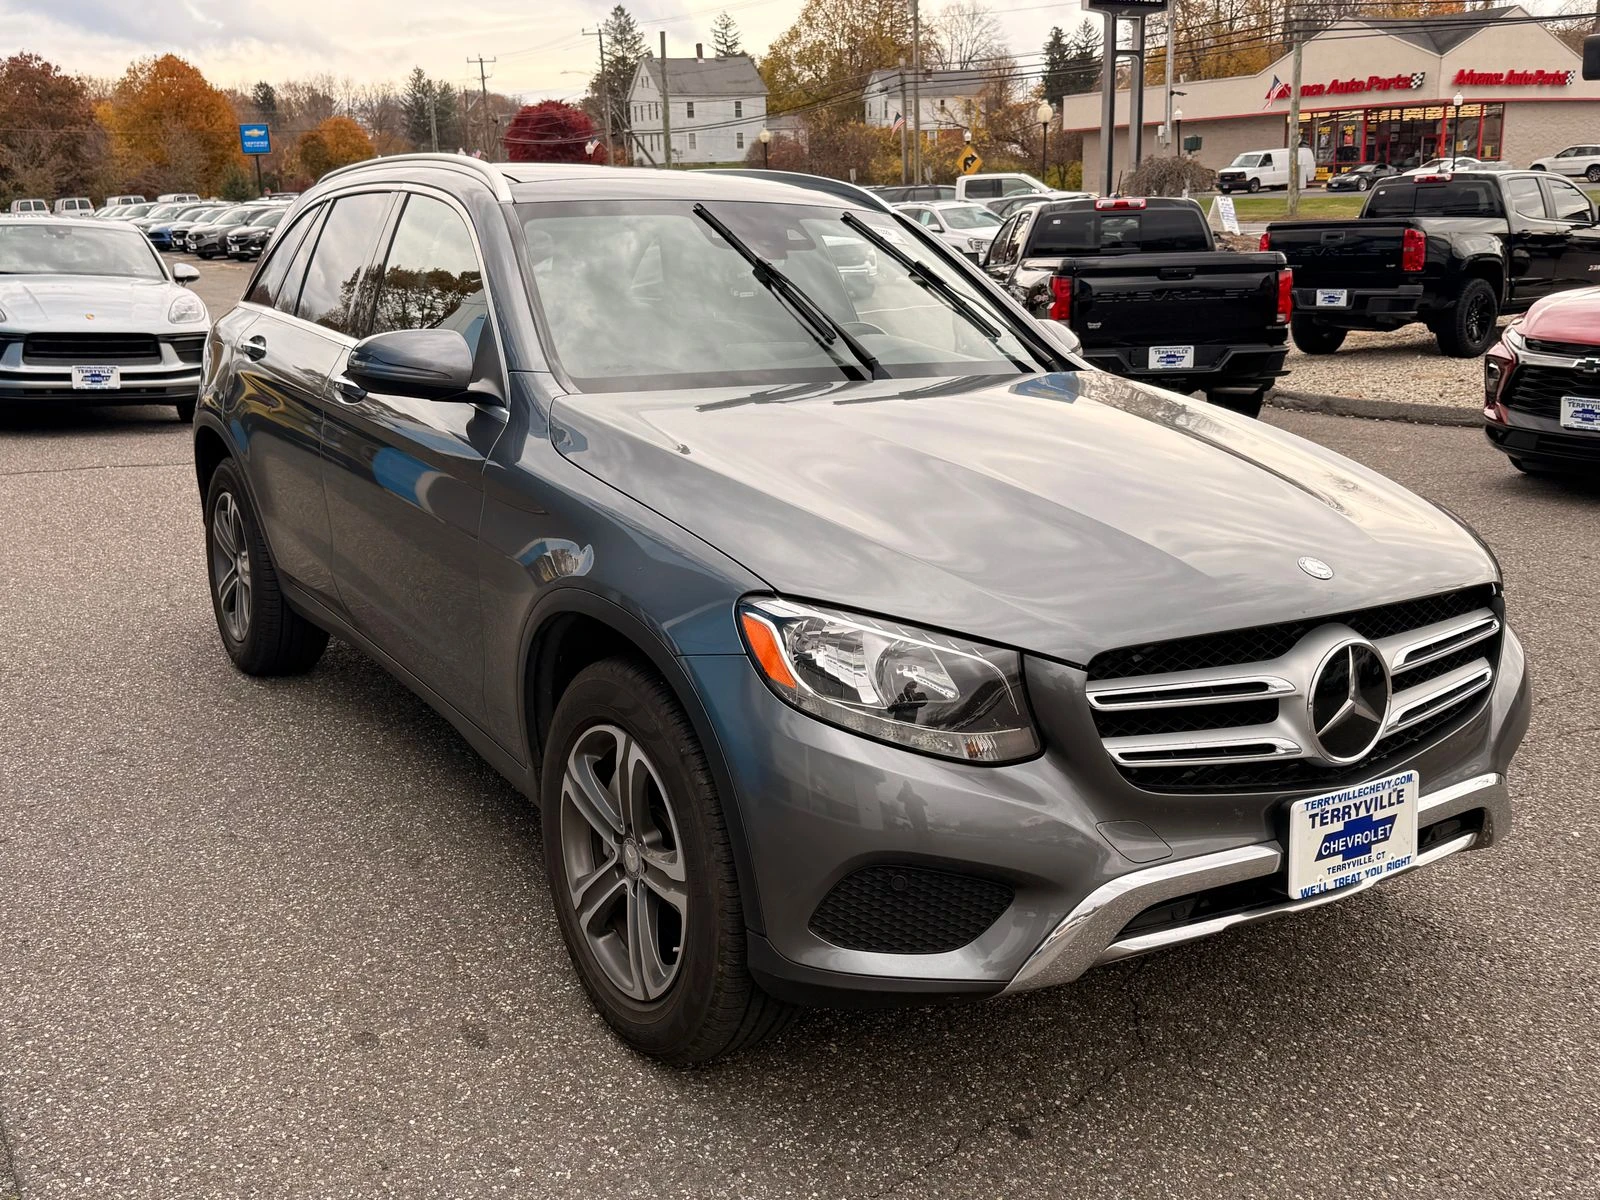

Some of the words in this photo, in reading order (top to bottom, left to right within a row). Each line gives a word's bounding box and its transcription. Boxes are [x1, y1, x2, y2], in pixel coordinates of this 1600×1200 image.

[1326, 78, 1366, 96] Auto
[1366, 74, 1412, 92] Parts
[1454, 69, 1504, 86] Advance
[1505, 69, 1534, 86] Auto
[1533, 69, 1568, 86] Parts
[1304, 773, 1414, 812] TERRYVILLECHEVY.COM
[1308, 788, 1405, 830] TERRYVILLE
[1321, 823, 1392, 856] CHEVROLET
[1300, 883, 1329, 899] WE'LL
[1333, 871, 1362, 889] TREAT
[1365, 865, 1383, 879] YOU
[1386, 855, 1412, 872] RIGHT
[1327, 856, 1375, 875] TERRYVILLE,
[1375, 851, 1387, 861] CT
